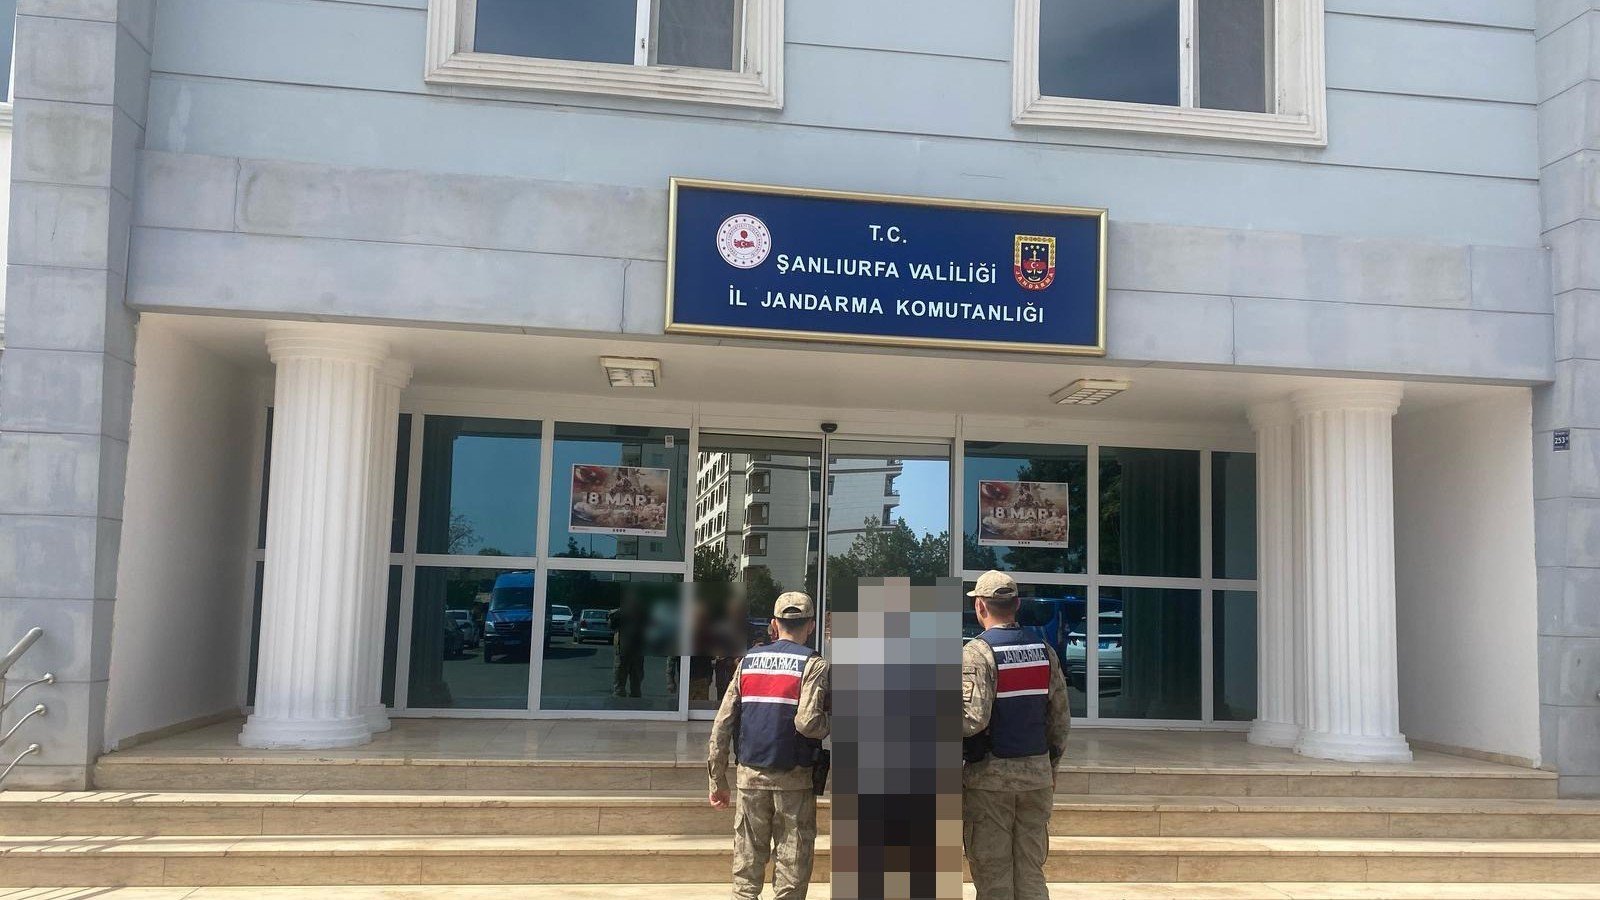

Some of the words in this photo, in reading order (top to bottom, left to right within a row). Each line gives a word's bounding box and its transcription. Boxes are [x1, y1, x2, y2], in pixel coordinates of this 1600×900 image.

[869, 224, 907, 244] T.C.
[776, 254, 900, 279] ŞANLIURFA
[908, 262, 996, 284] VALİLİĞİ
[728, 284, 748, 306] İL
[760, 291, 884, 316] JANDARMA
[896, 299, 1045, 323] KOMUTANLIĞI
[748, 656, 799, 671] JANDARMA
[1002, 648, 1047, 664] JANDARMA
